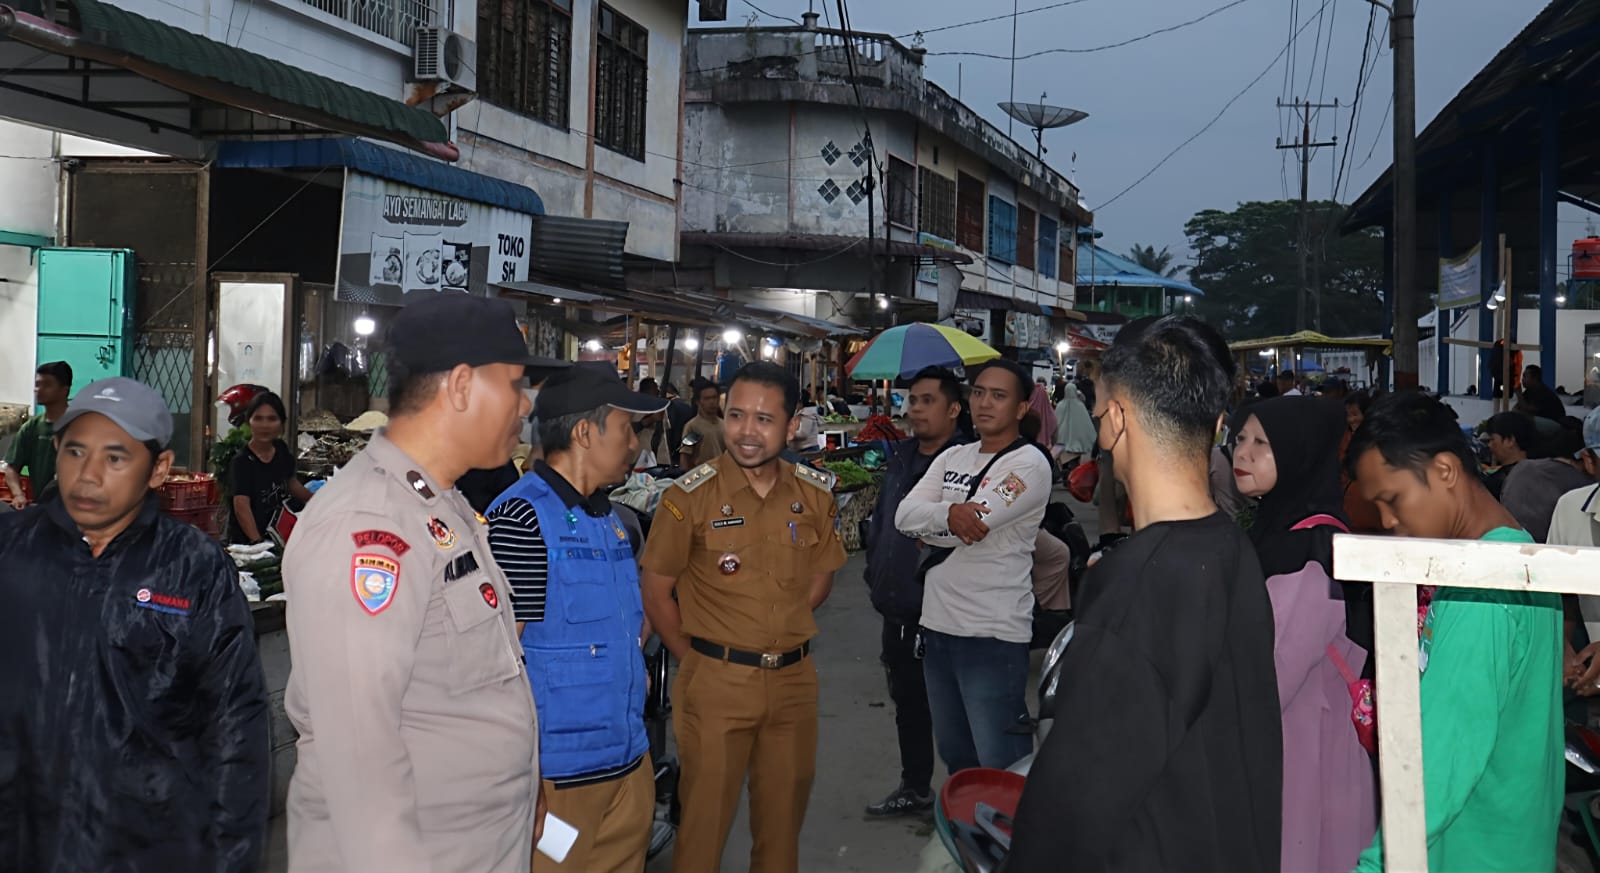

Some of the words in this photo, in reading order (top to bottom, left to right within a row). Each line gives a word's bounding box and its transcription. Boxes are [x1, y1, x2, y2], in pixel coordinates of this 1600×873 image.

[384, 195, 401, 217] AYO
[402, 197, 448, 219] SEMANGAT
[497, 233, 525, 258] TOKO
[502, 260, 517, 282] SH
